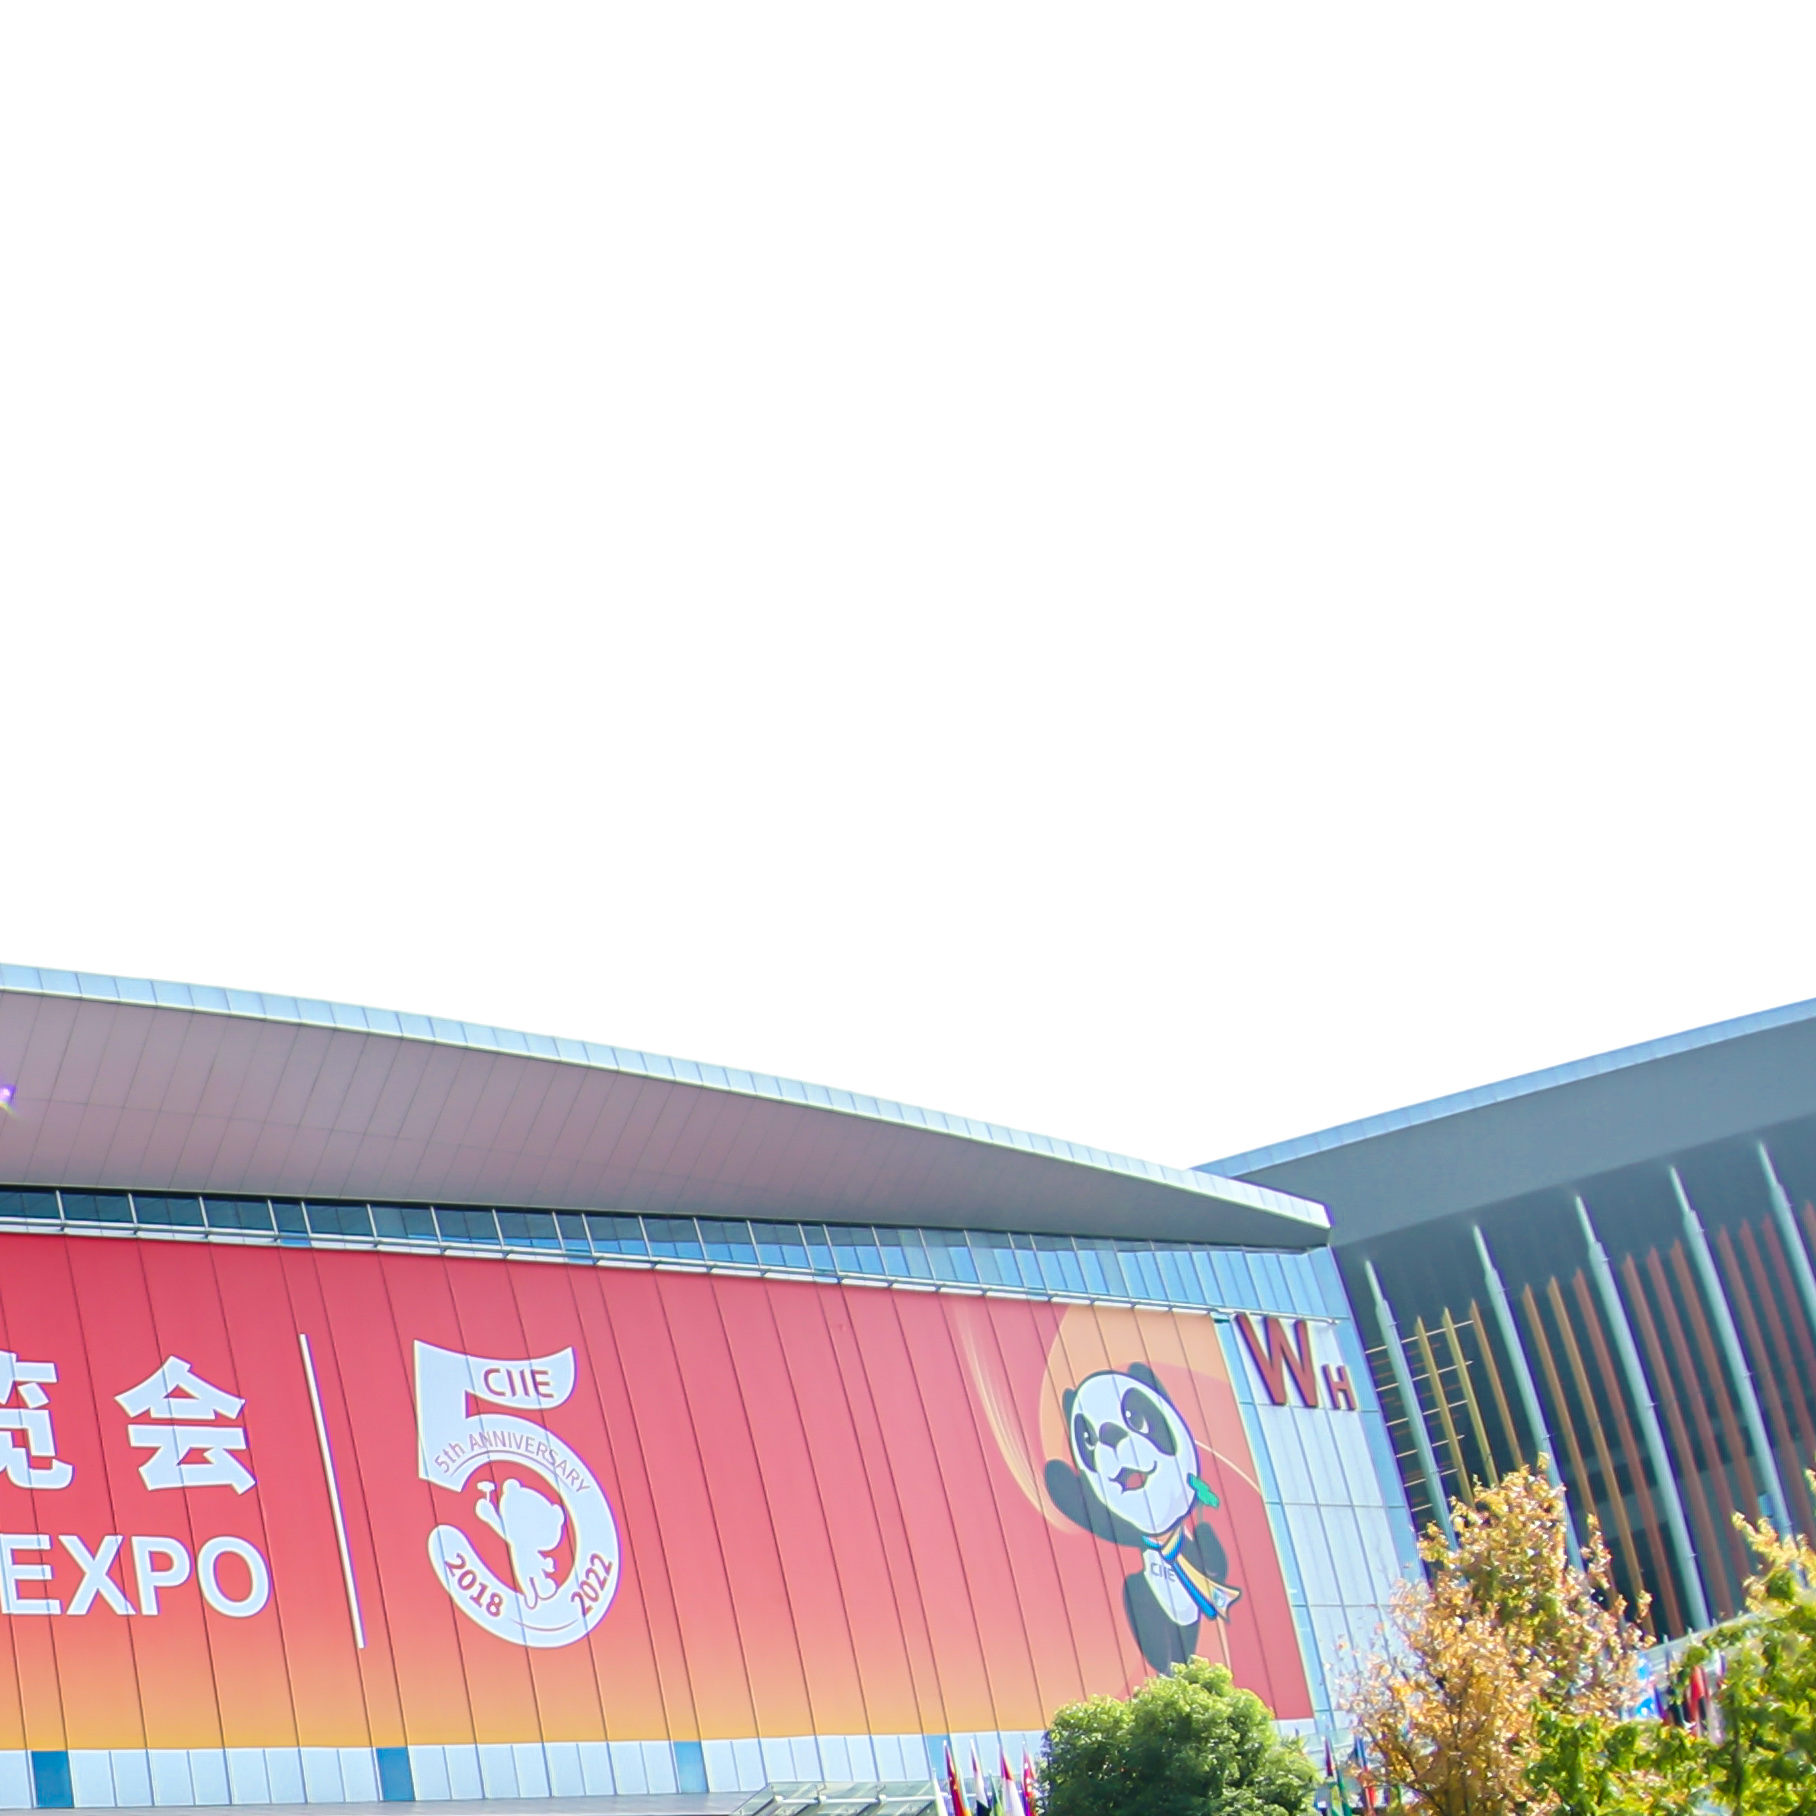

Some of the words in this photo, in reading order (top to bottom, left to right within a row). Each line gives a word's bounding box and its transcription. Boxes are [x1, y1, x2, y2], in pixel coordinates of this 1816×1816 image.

[483, 1367, 554, 1399] CIIE
[433, 1441, 466, 1474] 5th
[469, 1429, 591, 1494] ANNIVERSARY
[443, 1552, 505, 1618] 2018
[570, 1552, 614, 1617] 2022
